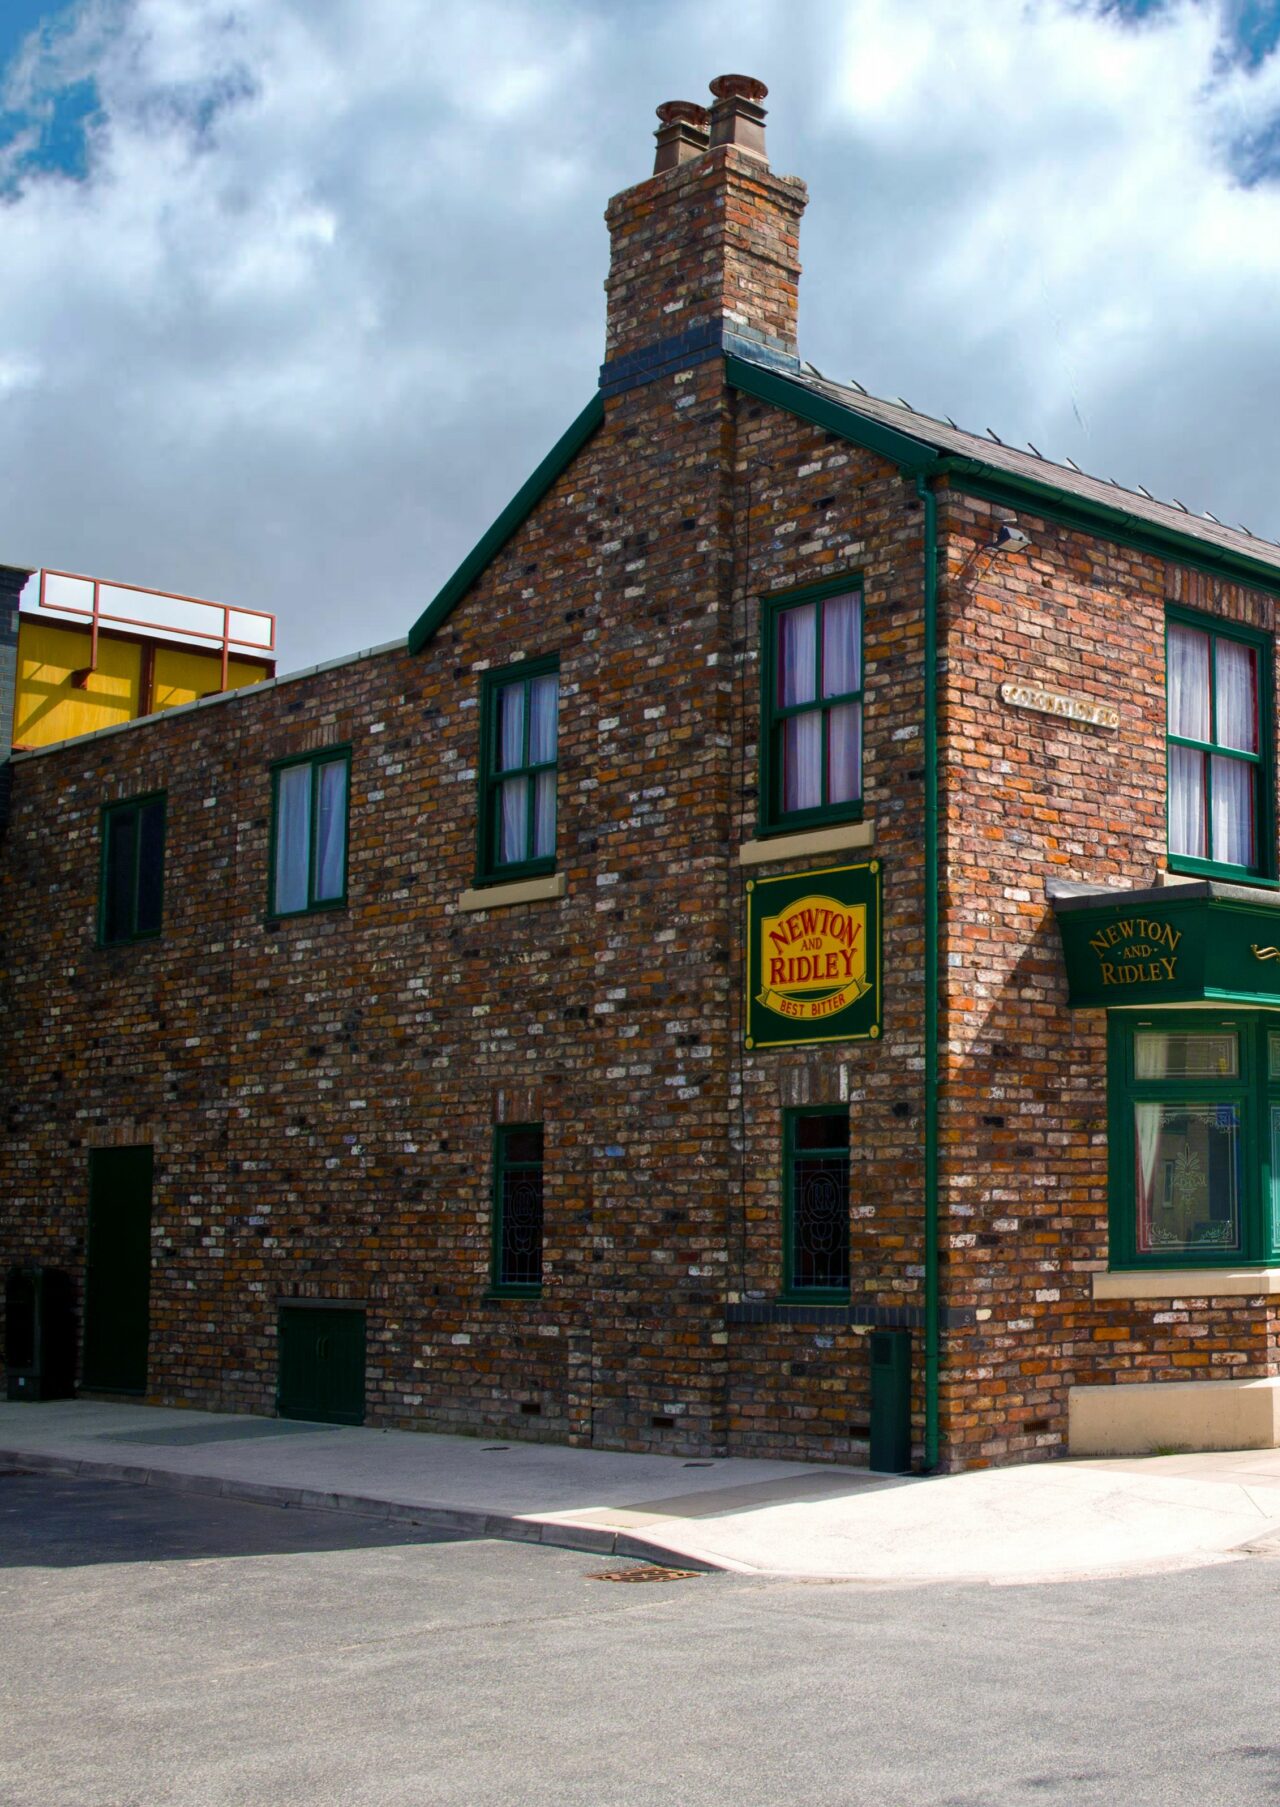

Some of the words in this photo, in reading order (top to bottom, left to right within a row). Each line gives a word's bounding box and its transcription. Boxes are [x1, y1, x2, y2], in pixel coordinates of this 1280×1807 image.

[769, 907, 862, 955] NEWTON
[801, 937, 823, 952] AND
[1089, 919, 1182, 958] NEWTON
[770, 948, 858, 986] RIDLEY
[1101, 957, 1178, 985] RIDLEY
[780, 999, 805, 1016] BEST
[811, 994, 846, 1016] BITTER
